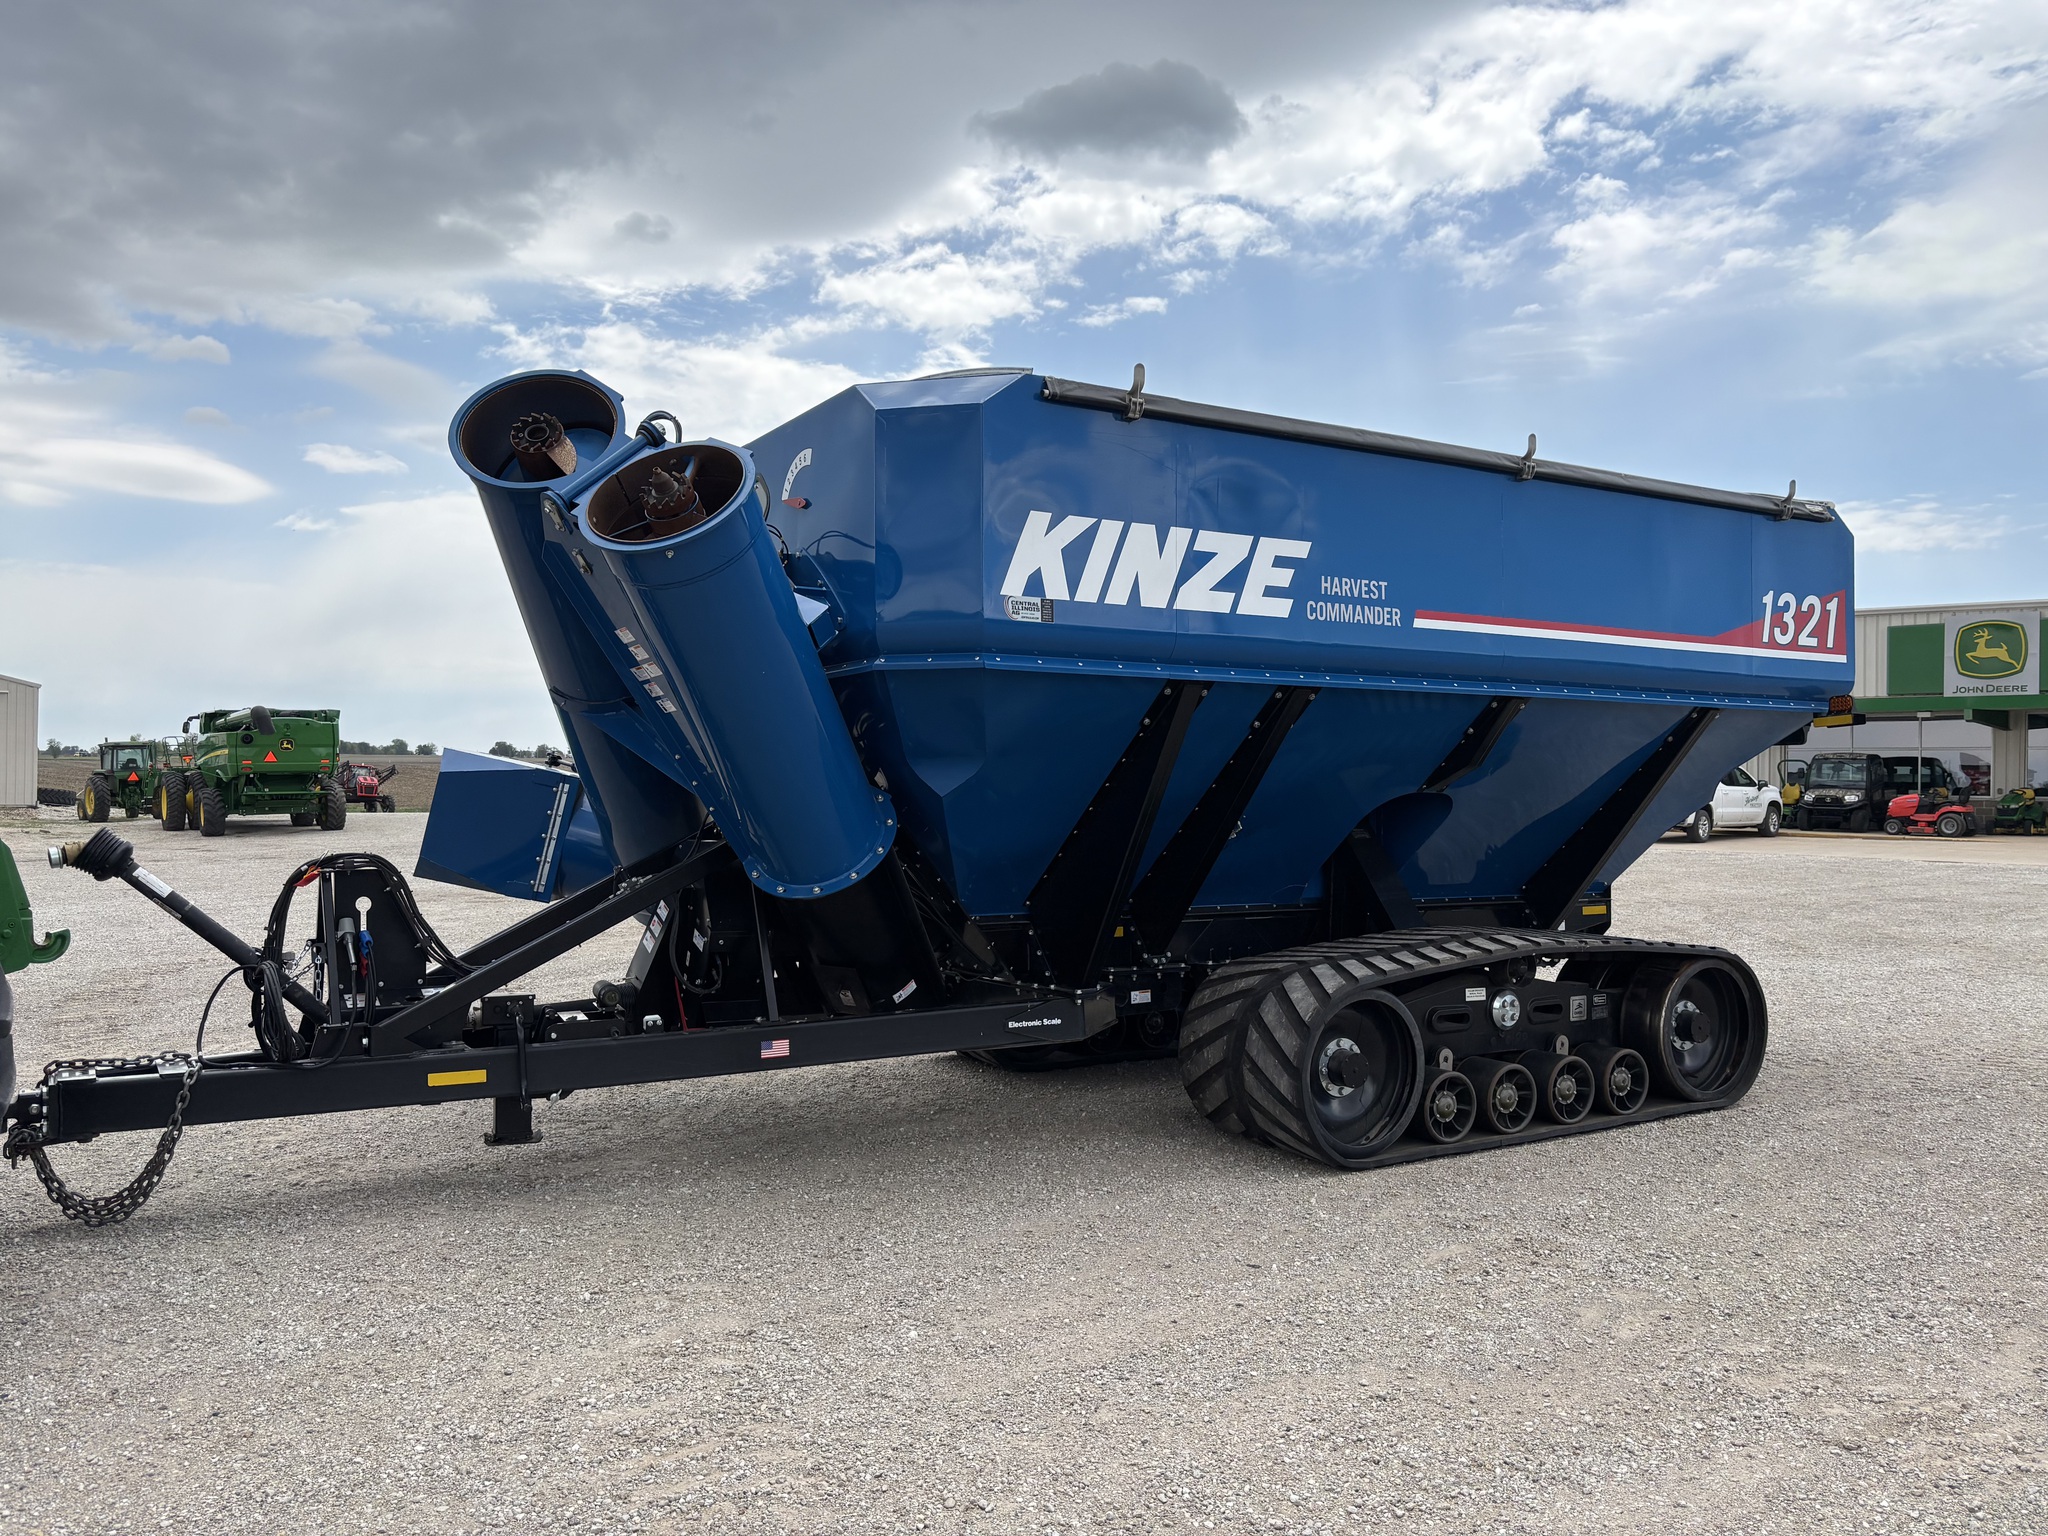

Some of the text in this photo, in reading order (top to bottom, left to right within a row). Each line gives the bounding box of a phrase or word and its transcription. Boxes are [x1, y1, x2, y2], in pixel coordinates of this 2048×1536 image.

[1000, 510, 1312, 618] KINZE
[1321, 575, 1388, 600] HARVEST
[1010, 600, 1039, 608] CENTRAL
[1306, 600, 1402, 627] COMMANDER
[1762, 590, 1839, 649] 1321
[1952, 684, 2029, 694] JOHN DEERE
[1008, 1017, 1062, 1028] Electronic Scale
